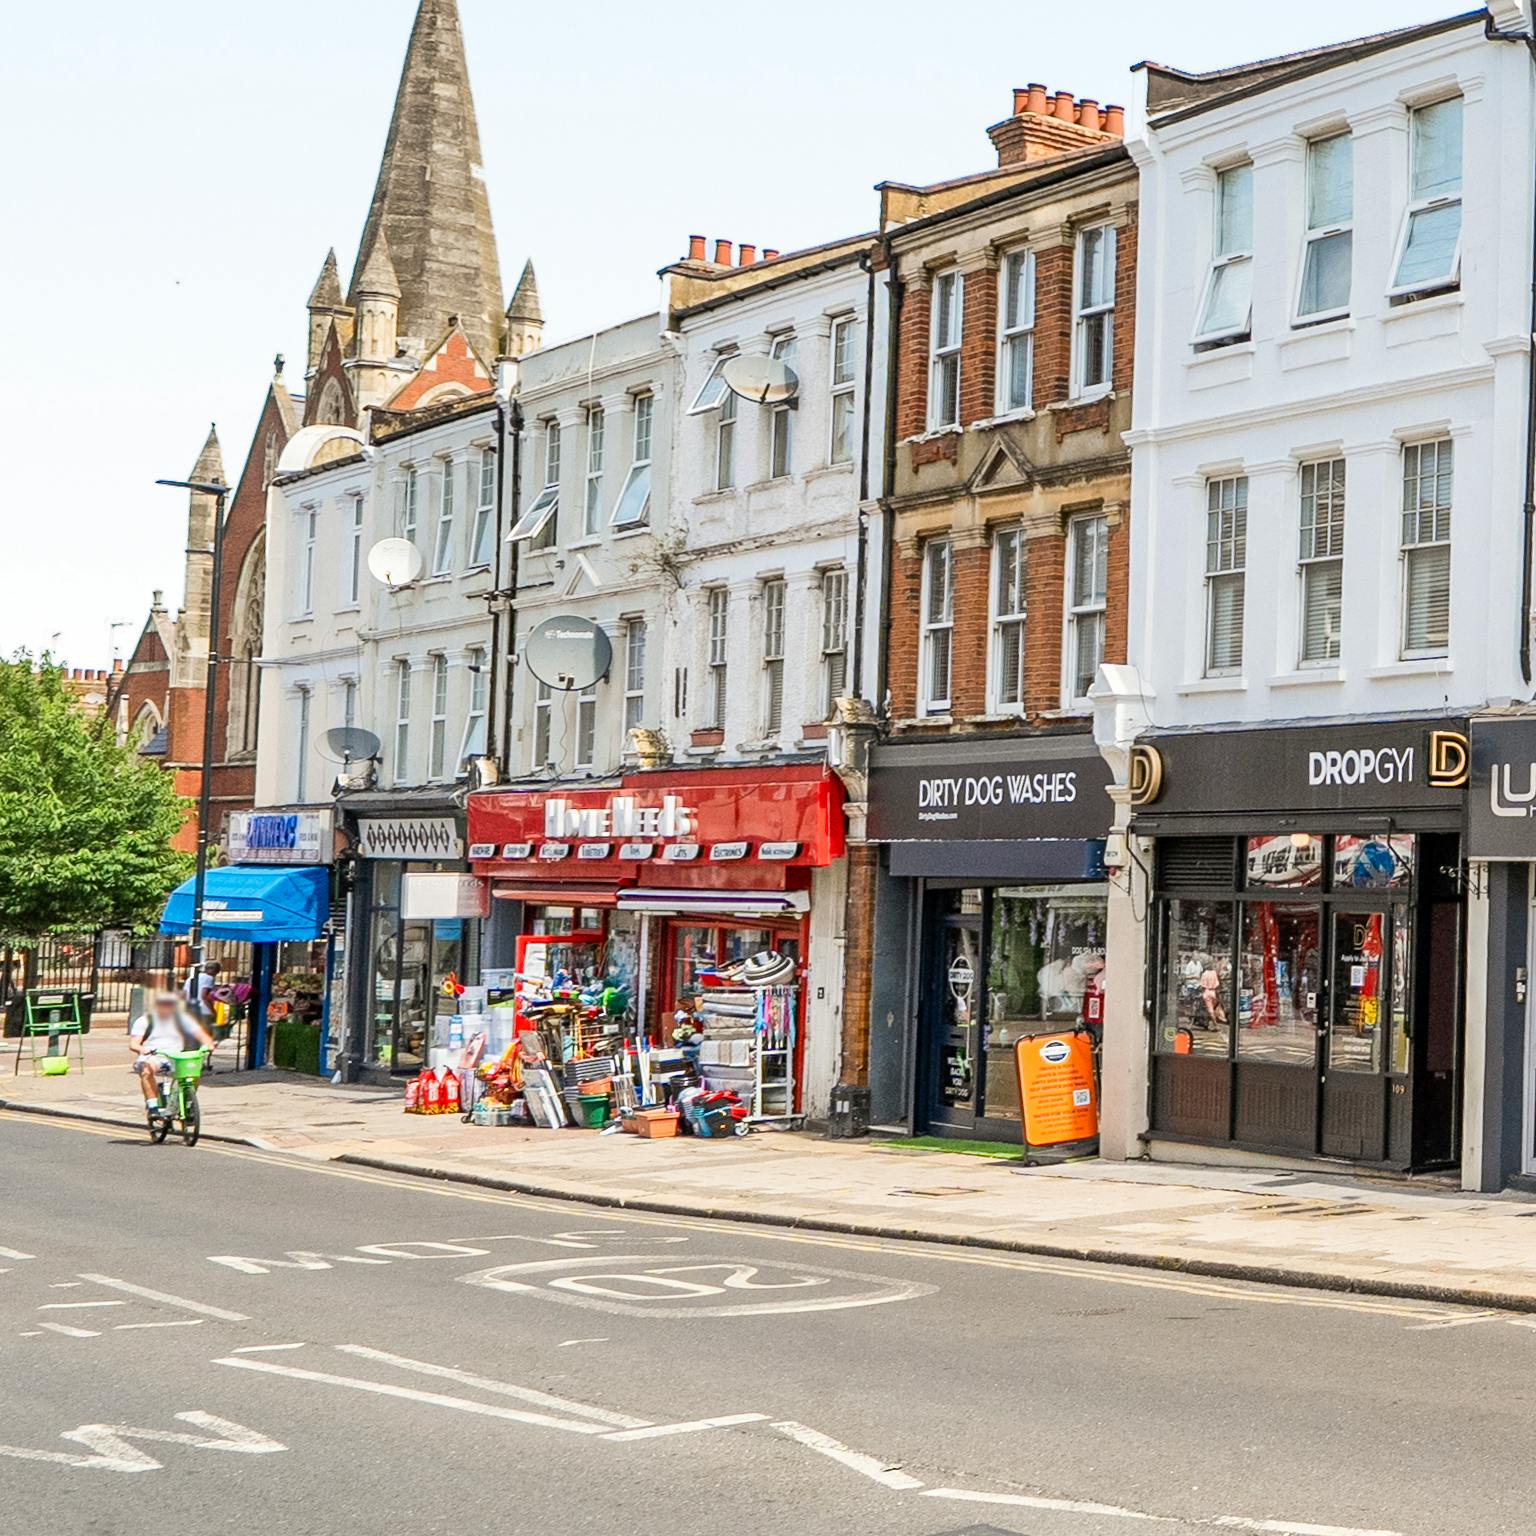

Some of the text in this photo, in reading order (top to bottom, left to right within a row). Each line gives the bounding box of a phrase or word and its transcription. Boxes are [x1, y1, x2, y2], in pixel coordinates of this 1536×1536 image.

[1428, 730, 1469, 787] D
[919, 768, 1077, 807] DIRTY DOG WASHES
